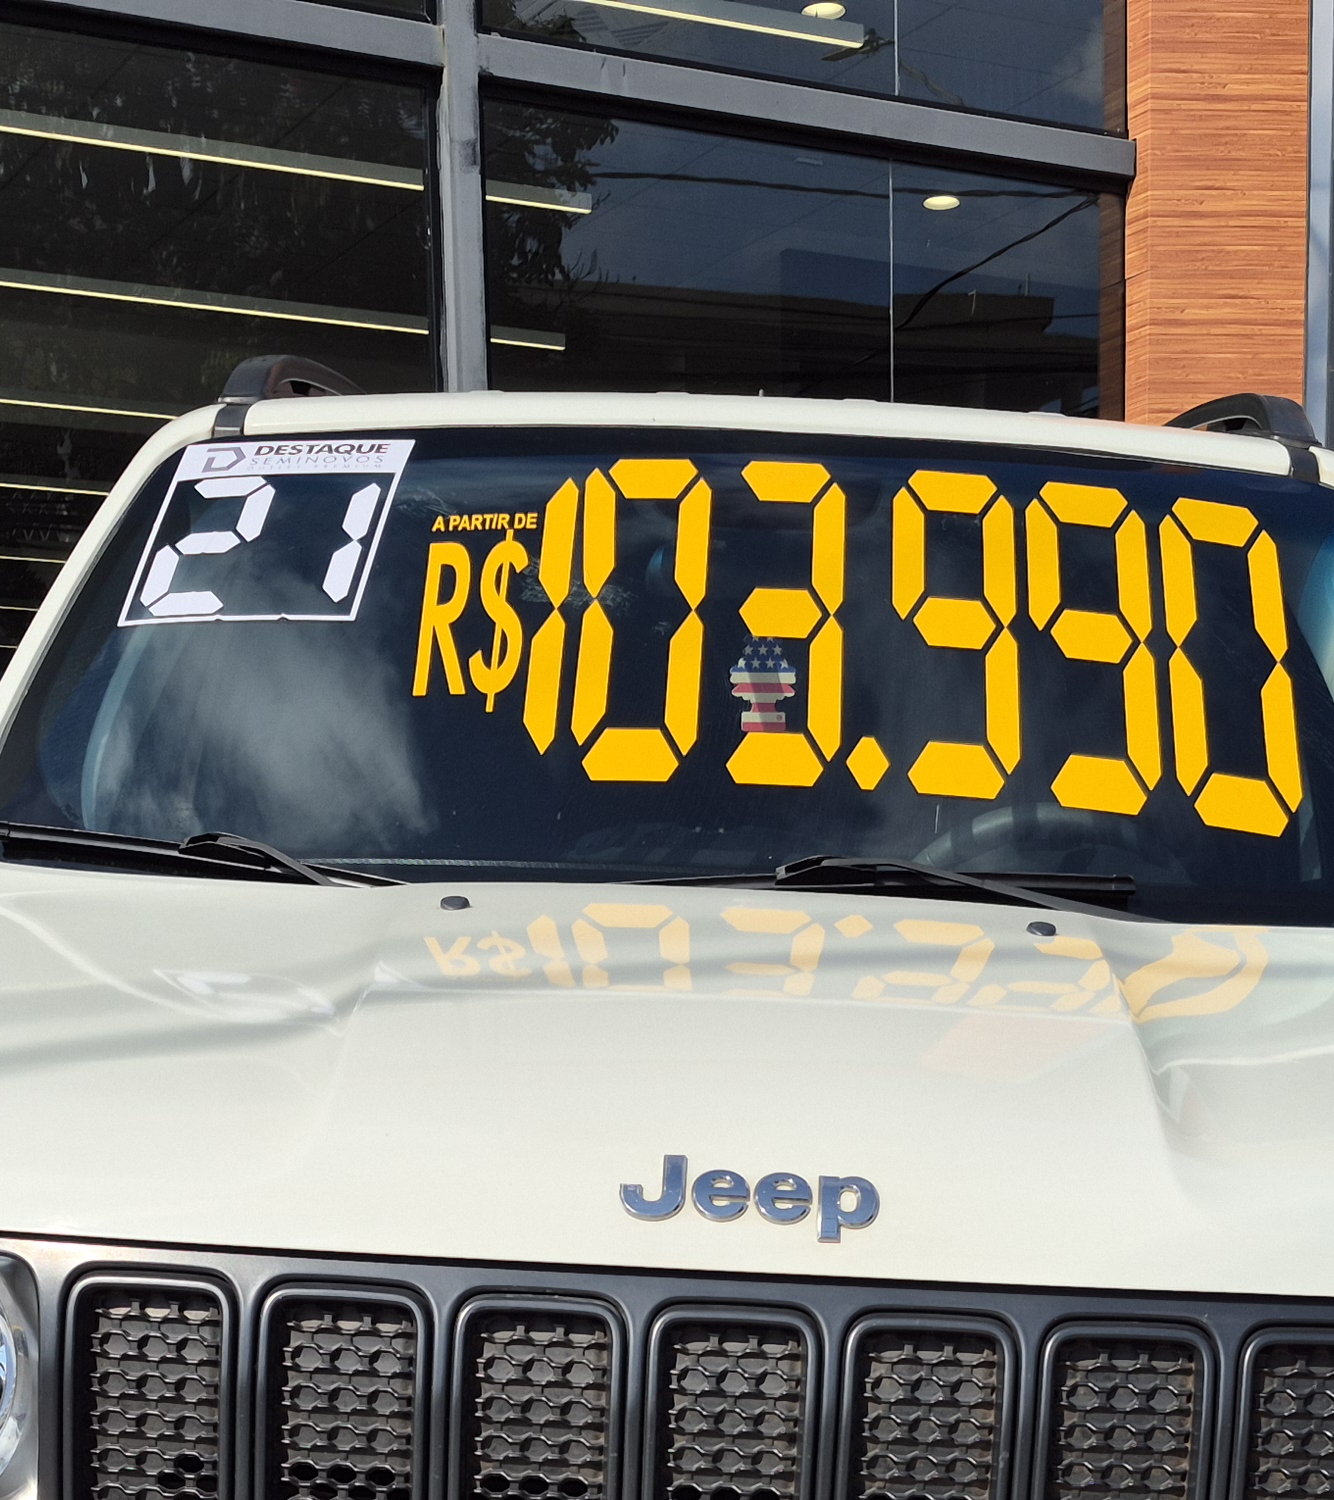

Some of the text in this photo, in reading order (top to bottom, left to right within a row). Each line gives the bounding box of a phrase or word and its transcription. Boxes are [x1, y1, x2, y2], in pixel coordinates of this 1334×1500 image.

[254, 443, 391, 456] DESTAQUE
[249, 455, 385, 466] SEMINOVOS
[431, 512, 538, 532] A PARTIR DE
[140, 476, 381, 615] 21
[619, 1155, 880, 1243] Jeep
